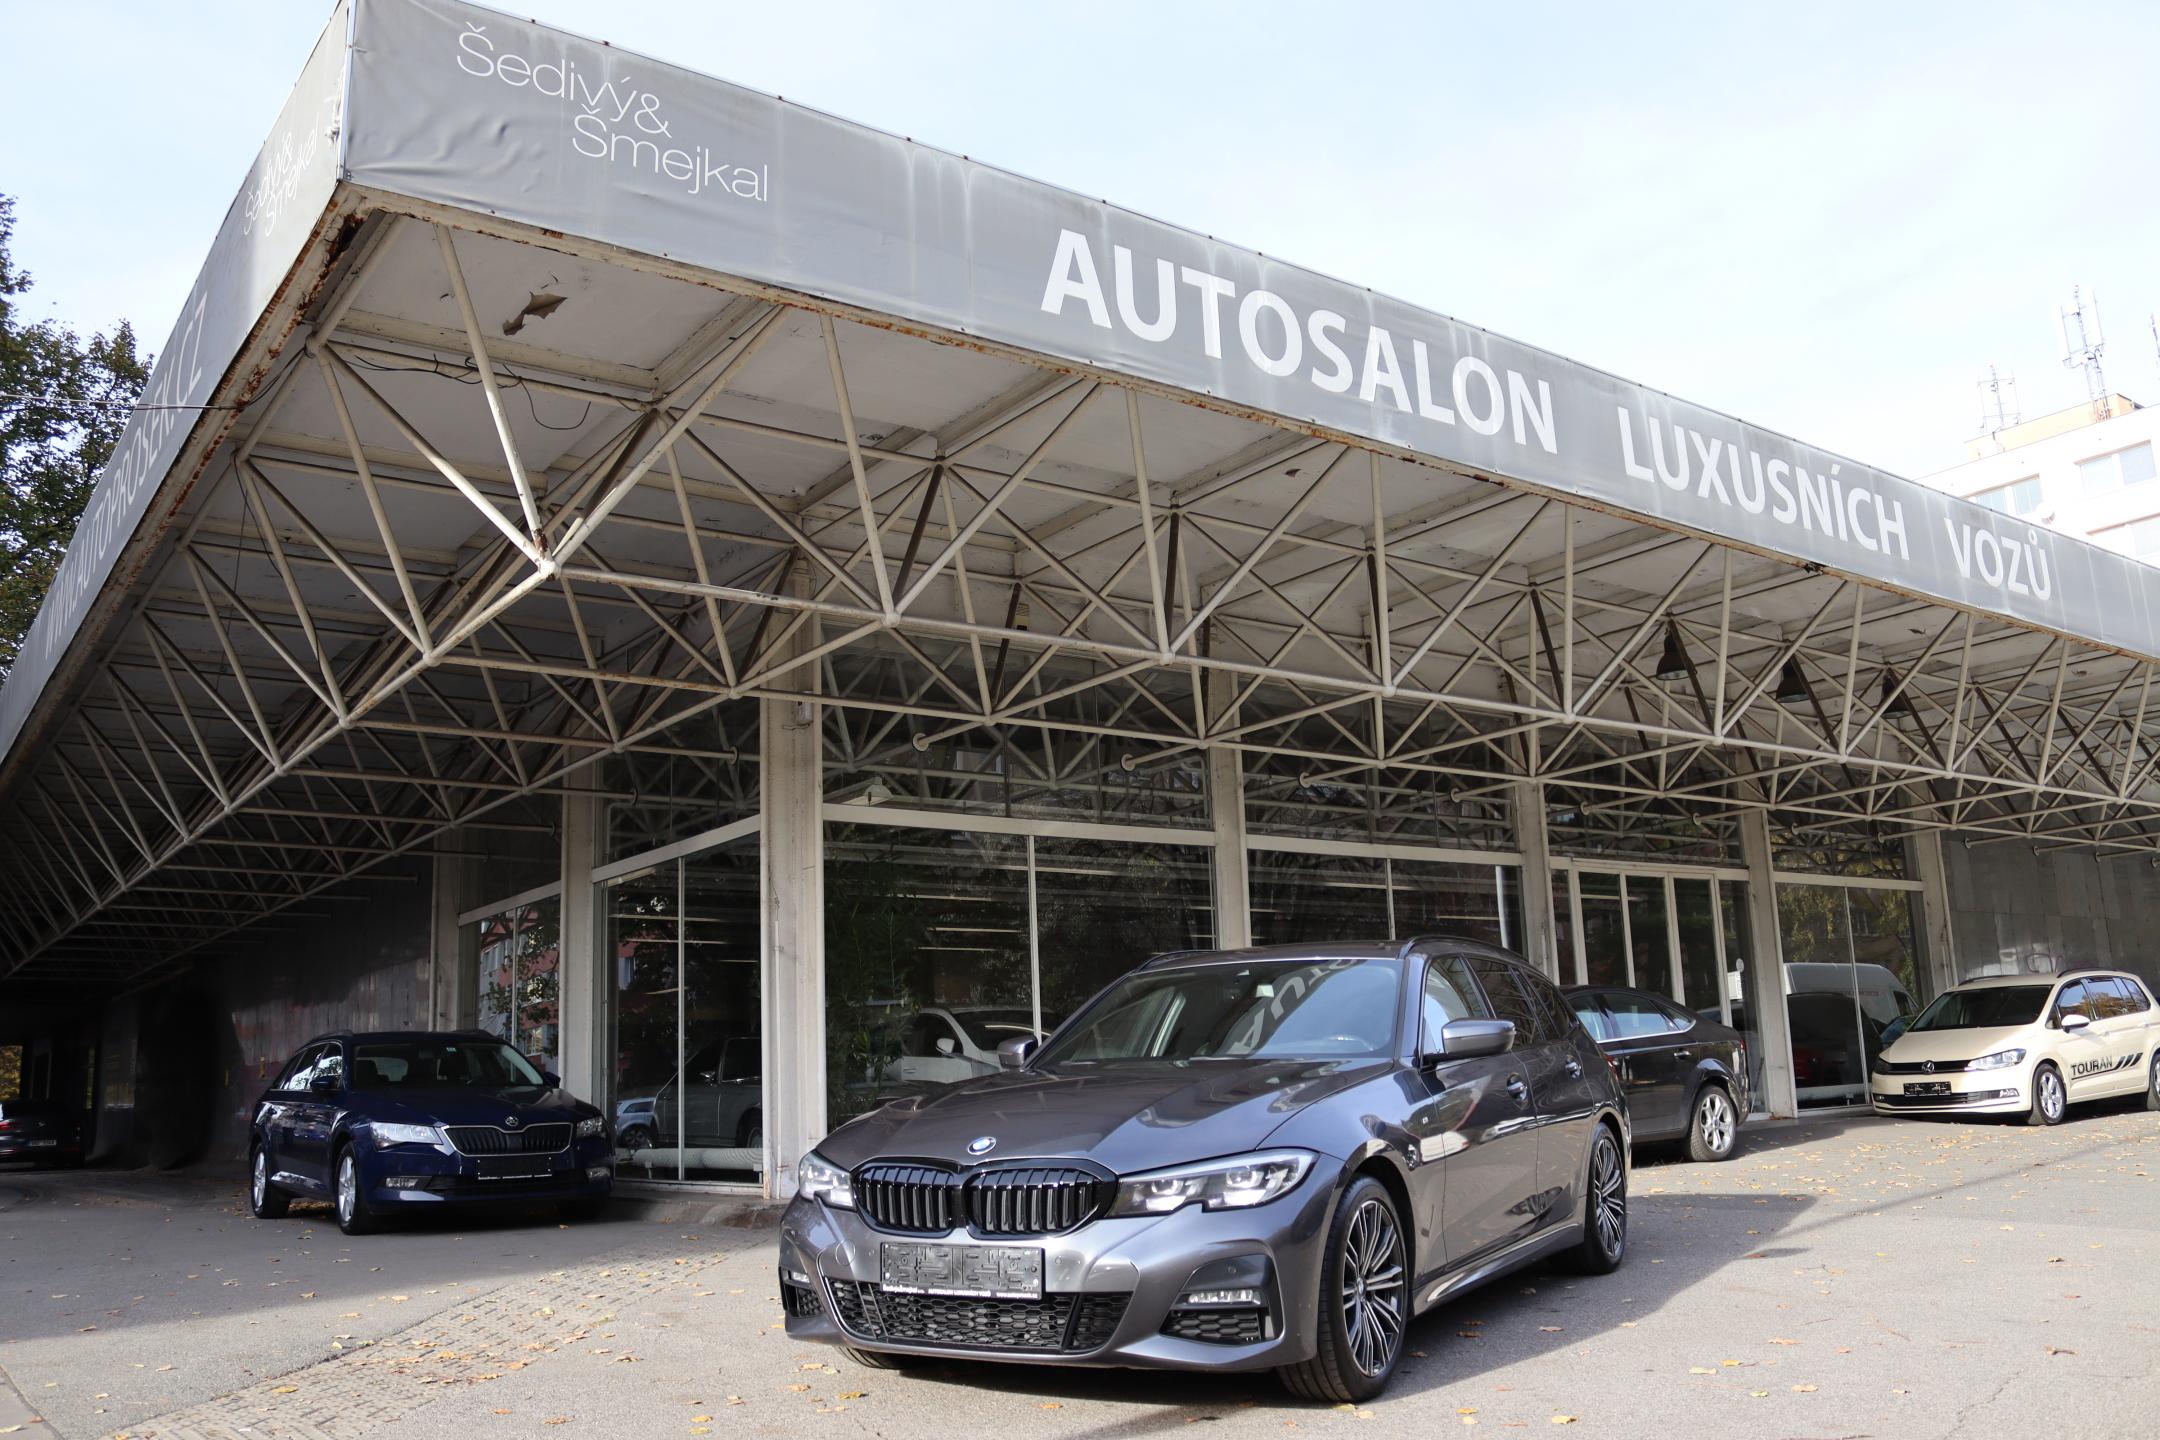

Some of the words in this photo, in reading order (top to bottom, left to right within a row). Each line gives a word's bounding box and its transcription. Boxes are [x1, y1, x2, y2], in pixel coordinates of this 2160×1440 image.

[572, 103, 767, 201] Šmejkal
[1041, 228, 1558, 455] AUTOSALON
[1617, 406, 1910, 560] LUXUSNÍCH
[1944, 517, 2051, 600] VOZŮ
[2071, 1056, 2112, 1076] TOURAN
